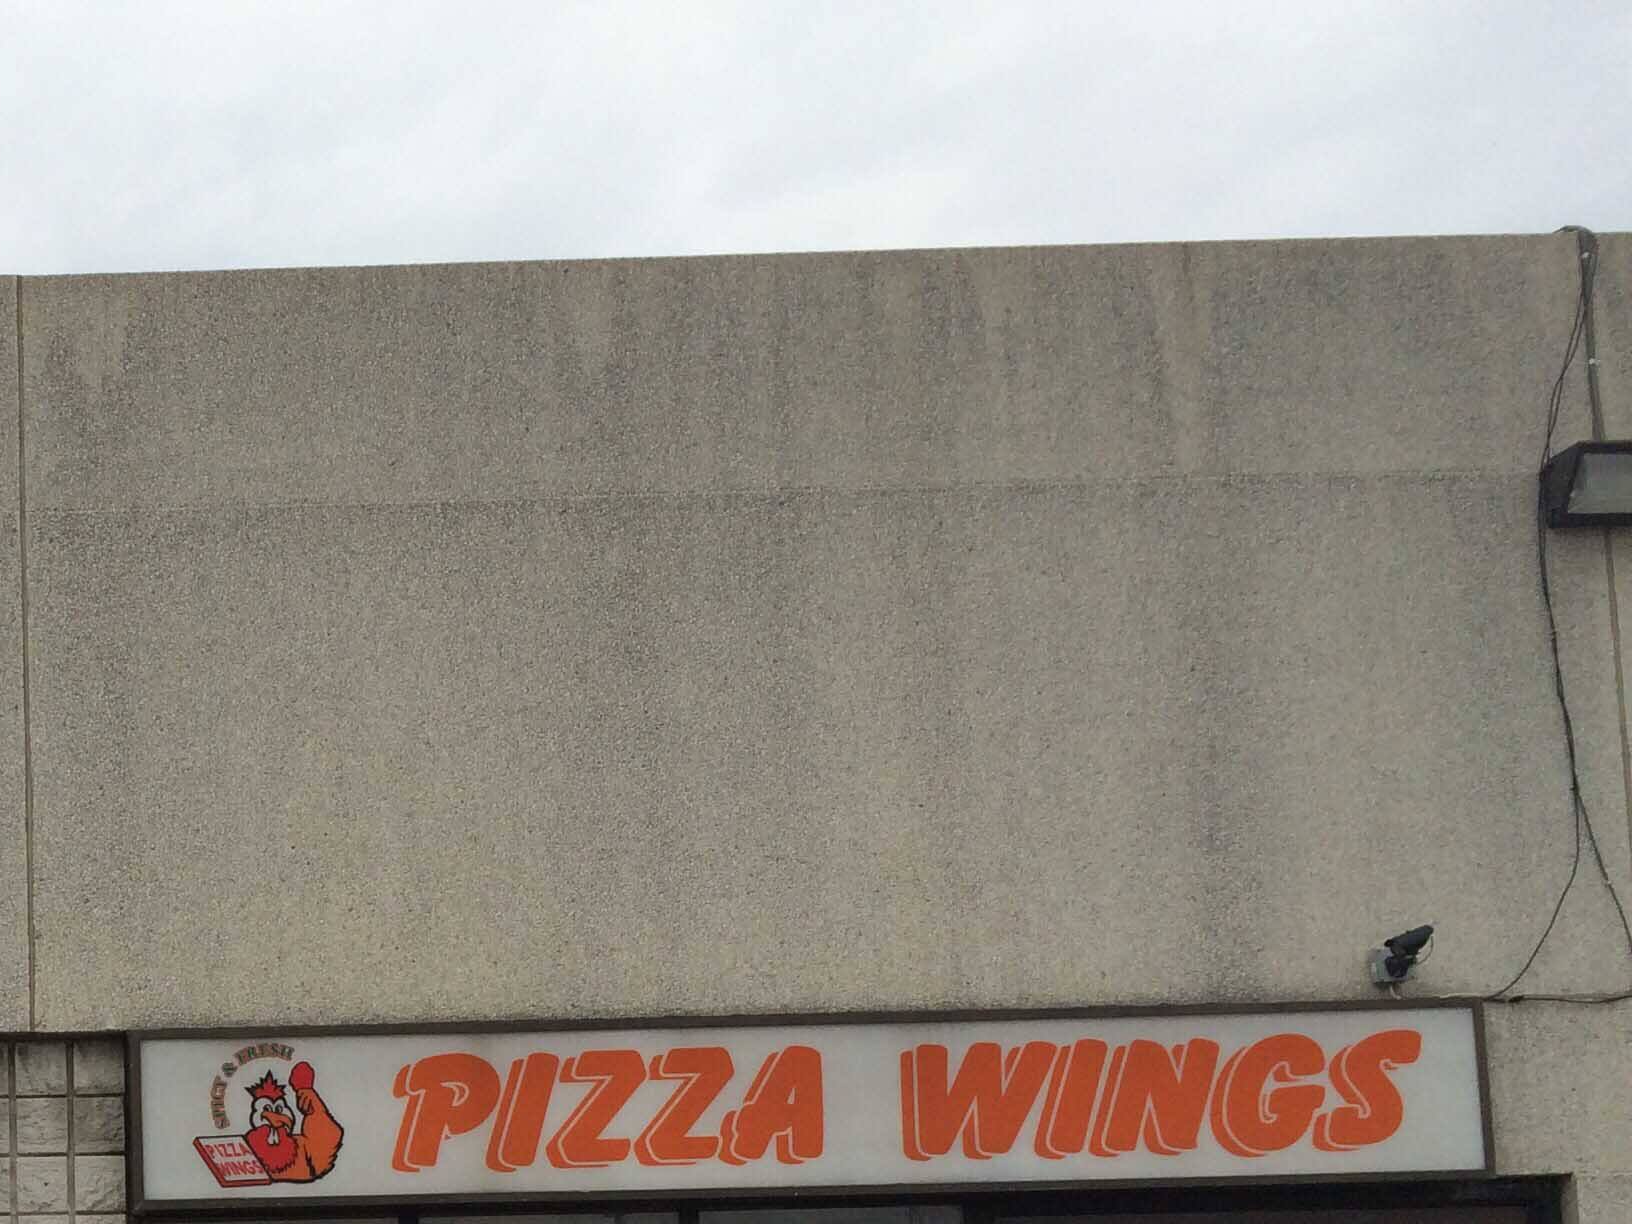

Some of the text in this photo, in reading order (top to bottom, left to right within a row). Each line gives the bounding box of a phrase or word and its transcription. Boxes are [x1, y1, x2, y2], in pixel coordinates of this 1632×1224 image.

[390, 1029, 1422, 1173] PIZZA WINGS
[205, 1142, 252, 1158] PIZZA
[217, 1160, 262, 1177] WINGS
